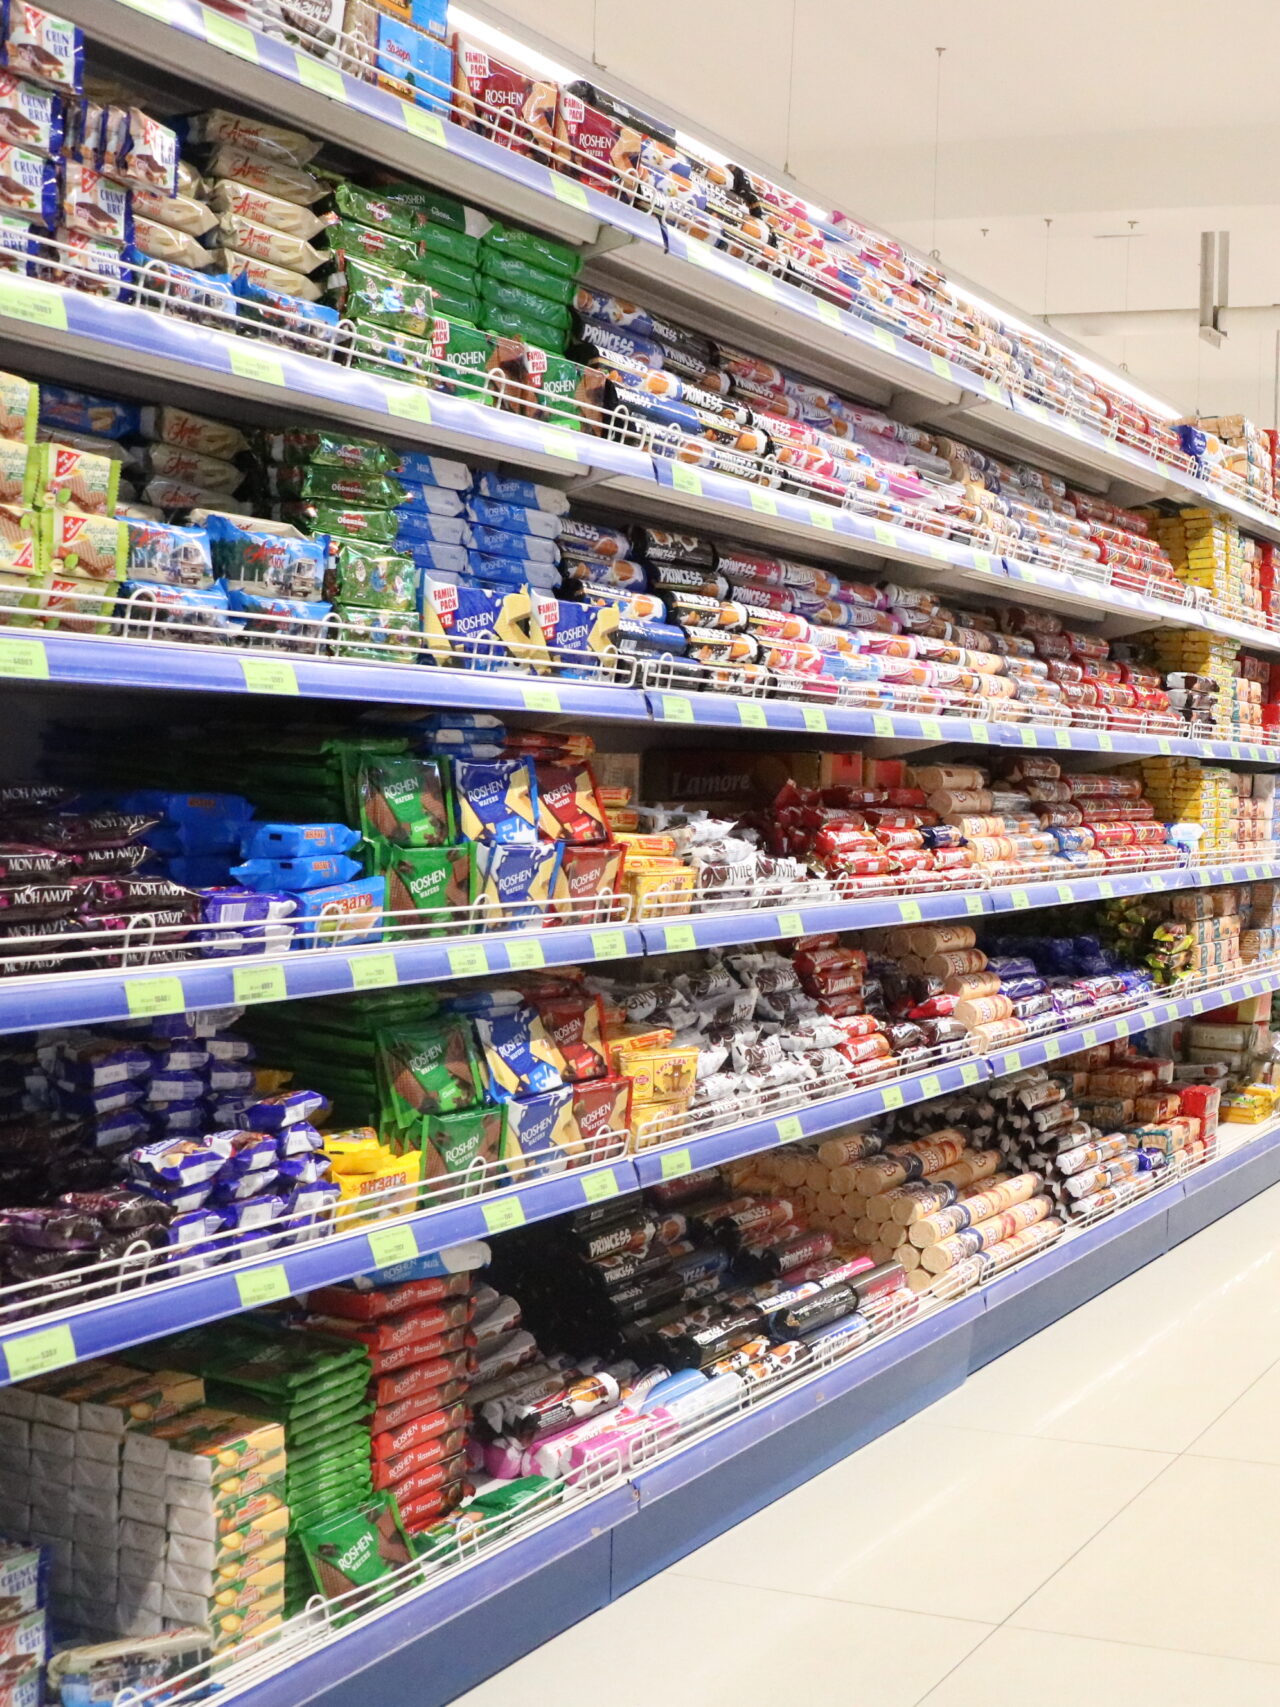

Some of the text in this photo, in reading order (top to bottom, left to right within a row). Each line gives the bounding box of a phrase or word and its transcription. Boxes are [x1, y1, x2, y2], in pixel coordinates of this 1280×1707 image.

[465, 51, 487, 65] FAMILY
[470, 63, 488, 77] PACK
[485, 89, 524, 105] ROSHEN
[564, 97, 585, 110] FAMILY
[569, 108, 584, 121] PACK
[579, 133, 612, 149] ROSHEN
[433, 317, 447, 331] MILY
[582, 323, 634, 355] PRINCESS
[447, 351, 486, 366] ROSHEN
[531, 360, 546, 373] PACK
[544, 380, 575, 394] ROSHEN
[682, 383, 722, 412] PRINCESS
[562, 519, 600, 541] INCESS
[660, 566, 702, 586] PRINCESS
[718, 557, 757, 578] PRINCESS
[433, 587, 455, 600] FAMILY
[440, 599, 457, 610] PACK
[732, 585, 771, 607] PRINCESS
[537, 604, 557, 616] FAMILY
[544, 612, 558, 625] PACK
[456, 611, 494, 632] ROSHEN
[556, 625, 588, 643] ROSHEN
[383, 777, 419, 799] ROSHEN
[468, 780, 504, 802] ROSHEN
[543, 783, 572, 805] ROSHEN
[410, 868, 447, 894] ROSHEN
[499, 868, 532, 891] ROSHEN
[571, 868, 601, 890] ROSHEN
[553, 1017, 581, 1042] ROSHEN
[498, 1031, 526, 1059] ROSHEN
[409, 1043, 443, 1072] ROSHEN
[580, 1101, 612, 1128] ROSHEN
[521, 1116, 552, 1144] ROSHEN
[445, 1134, 480, 1163] ROSHEN
[731, 1206, 771, 1225] PRINCESS
[589, 1228, 631, 1257] PRINCESS
[779, 1246, 813, 1272] PRINCESS
[603, 1264, 634, 1283] PRINCESS
[381, 1345, 410, 1369] ROSHEN
[394, 1369, 421, 1394] ROSHEN
[393, 1424, 418, 1449] ROSHEN
[388, 1453, 414, 1478] ROSHEN
[394, 1478, 415, 1499] OSHEN
[415, 1497, 442, 1513] Hazelnut
[338, 1532, 374, 1571] ROSHEN
